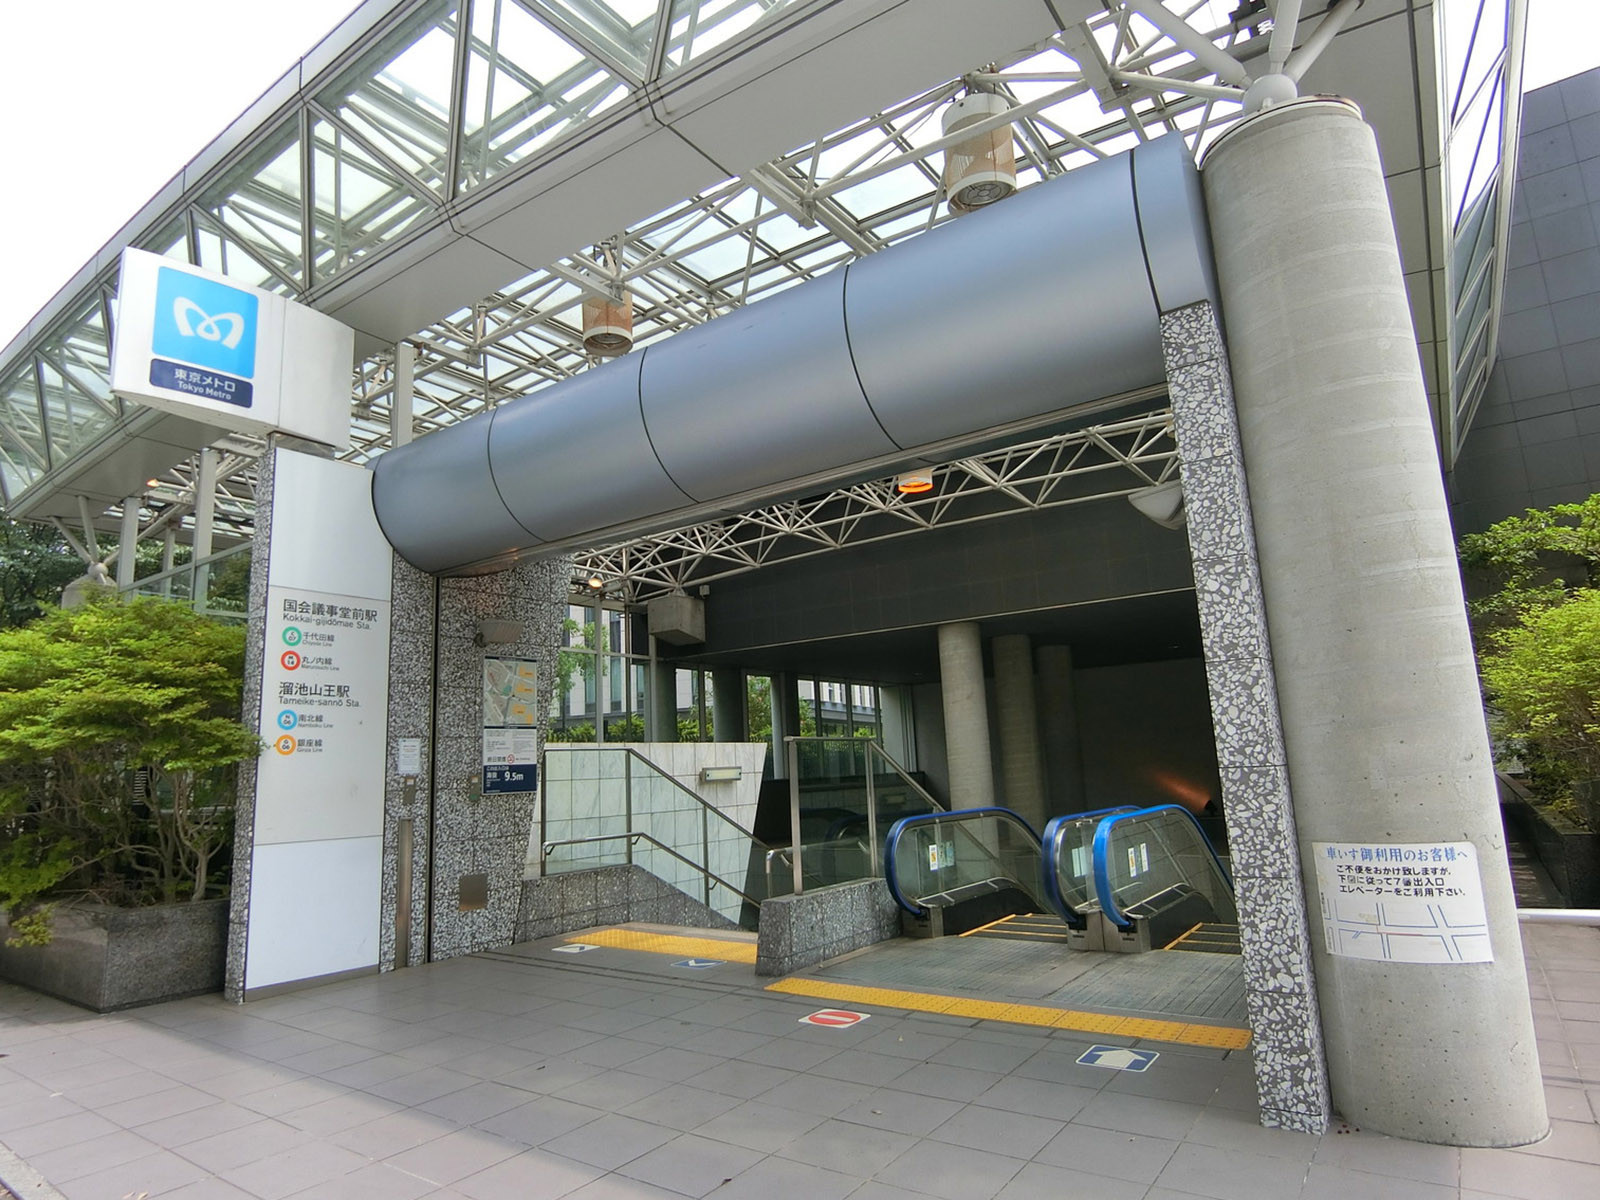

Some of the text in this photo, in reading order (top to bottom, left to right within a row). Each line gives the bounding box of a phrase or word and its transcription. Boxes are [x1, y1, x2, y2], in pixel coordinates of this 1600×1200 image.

[174, 368, 236, 393] 東京メトロ
[177, 380, 232, 400] Tokyo Metro
[283, 599, 378, 622] 国会議事堂前駅
[303, 632, 335, 642] 千代田線
[301, 656, 333, 666] 丸ノ内線
[279, 681, 350, 697] 溜池山王駅
[298, 714, 323, 723] 南北線
[297, 738, 323, 748] 銀座線
[504, 771, 524, 782] 9.5m
[1326, 846, 1468, 863] 車いす御利用のお客様へ
